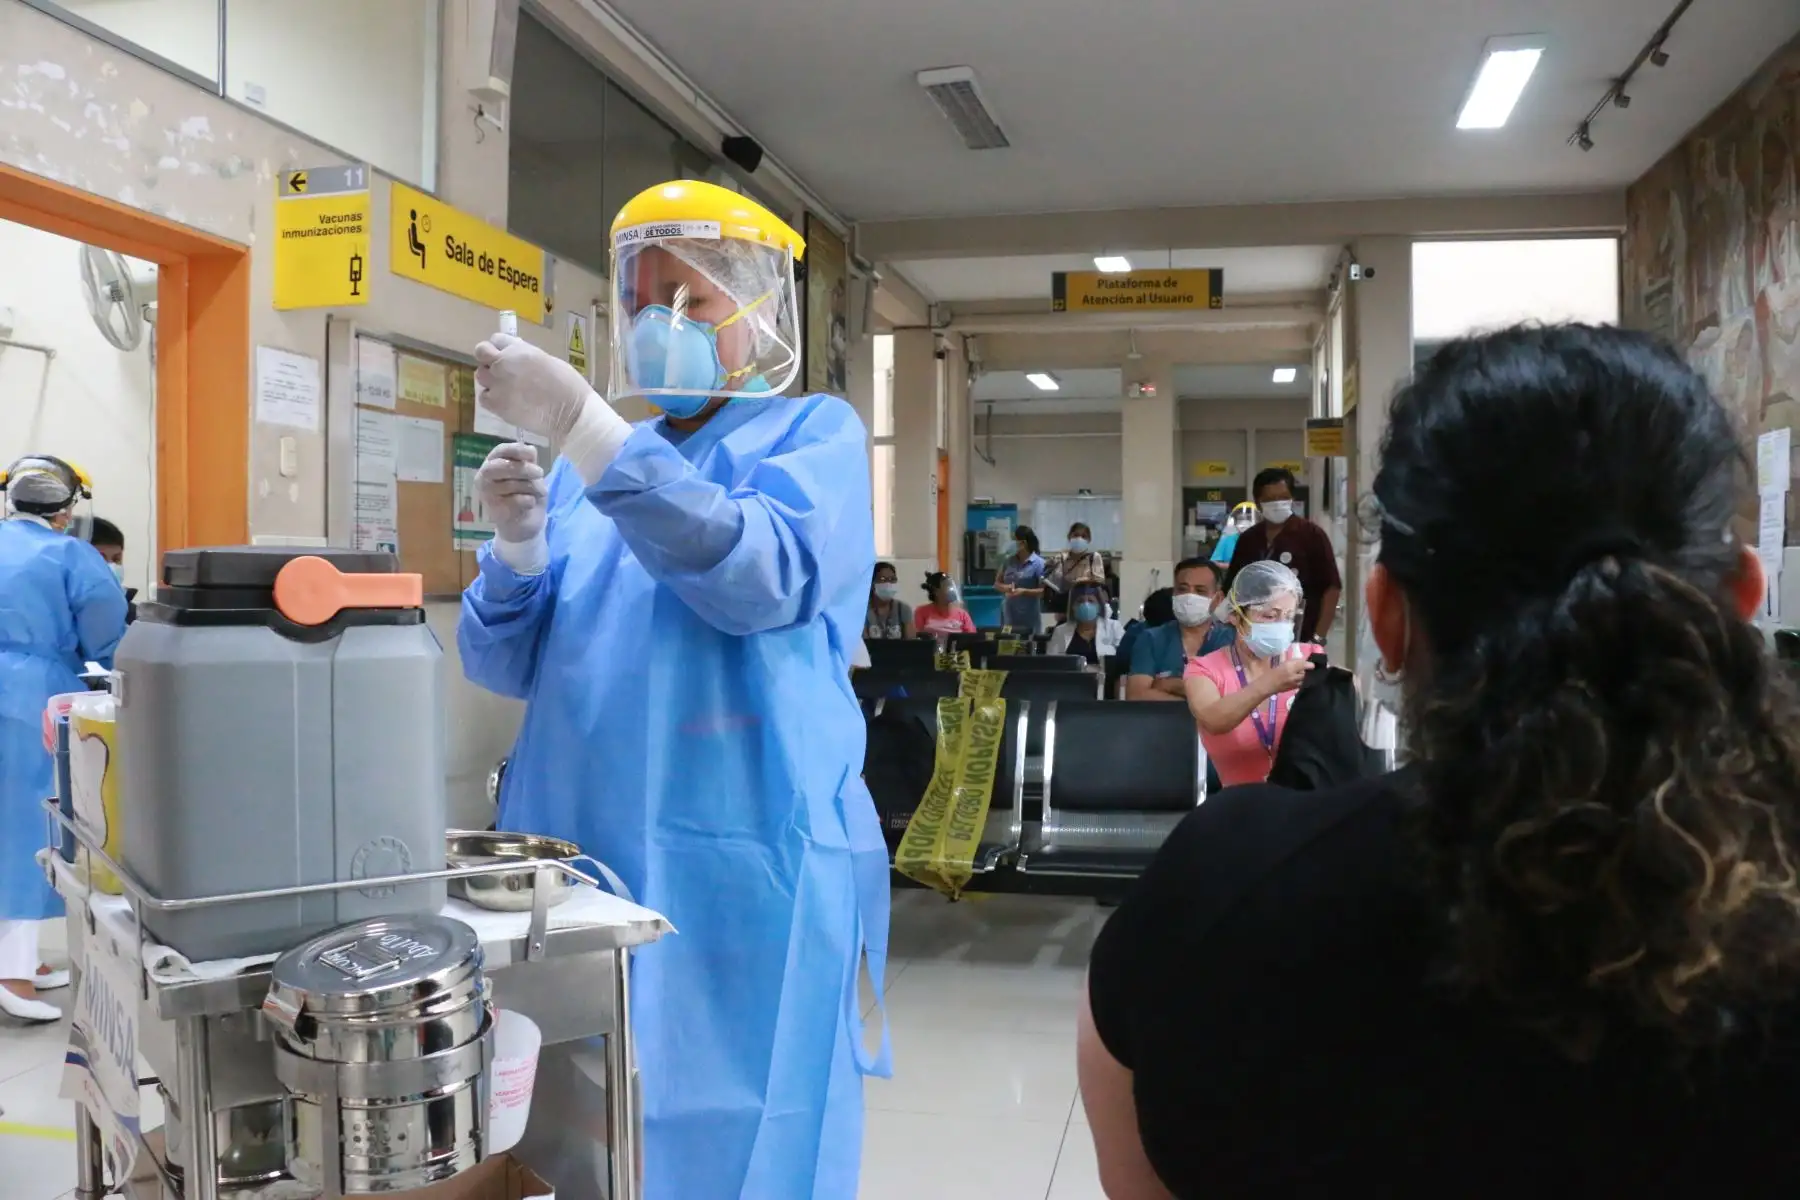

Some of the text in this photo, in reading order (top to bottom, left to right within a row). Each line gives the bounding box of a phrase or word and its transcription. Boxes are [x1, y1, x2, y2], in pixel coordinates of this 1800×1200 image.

[344, 167, 364, 187] 11
[319, 212, 363, 225] Vacunas
[645, 229, 654, 237] DE
[655, 227, 682, 236] TODOS
[445, 234, 539, 293] Sala de Espera
[1097, 276, 1178, 290] Plataforma de
[1082, 293, 1194, 306] Atención al Usuario
[85, 953, 138, 1092] MINSA
